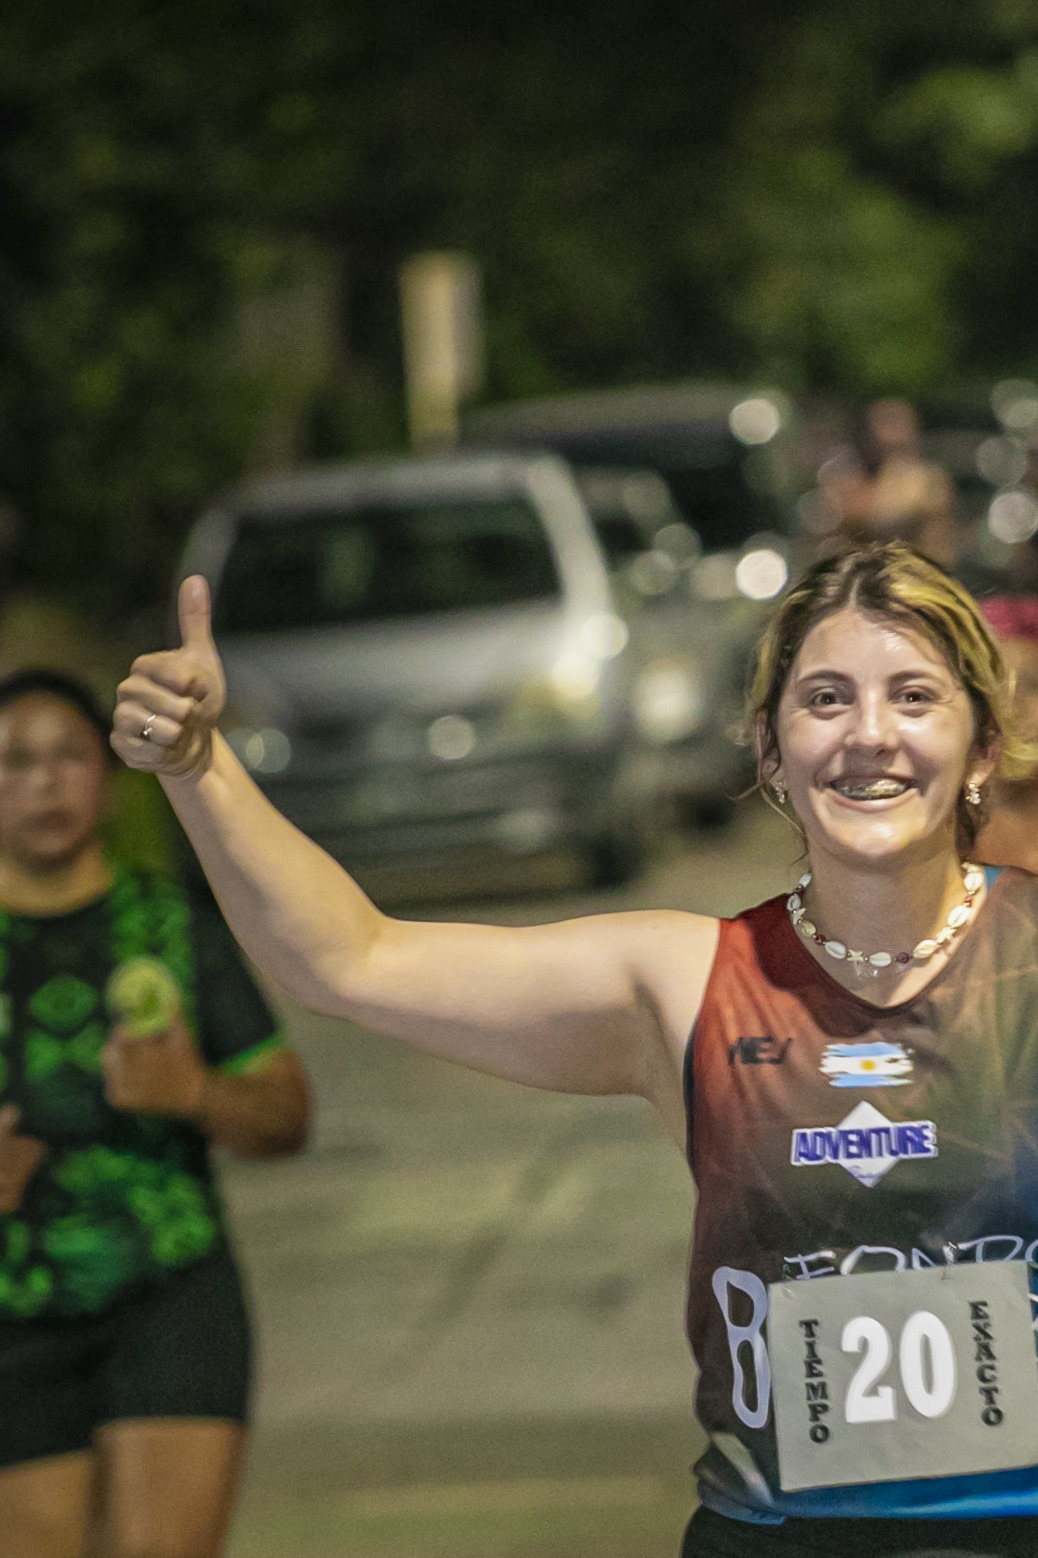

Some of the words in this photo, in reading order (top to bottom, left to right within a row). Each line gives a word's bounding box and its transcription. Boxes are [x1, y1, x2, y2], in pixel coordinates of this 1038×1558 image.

[794, 1123, 935, 1163] ADVENTURE
[799, 1318, 830, 1443] TIEMPO
[841, 1310, 957, 1423] 20
[969, 1300, 1004, 1426] EXACTO
